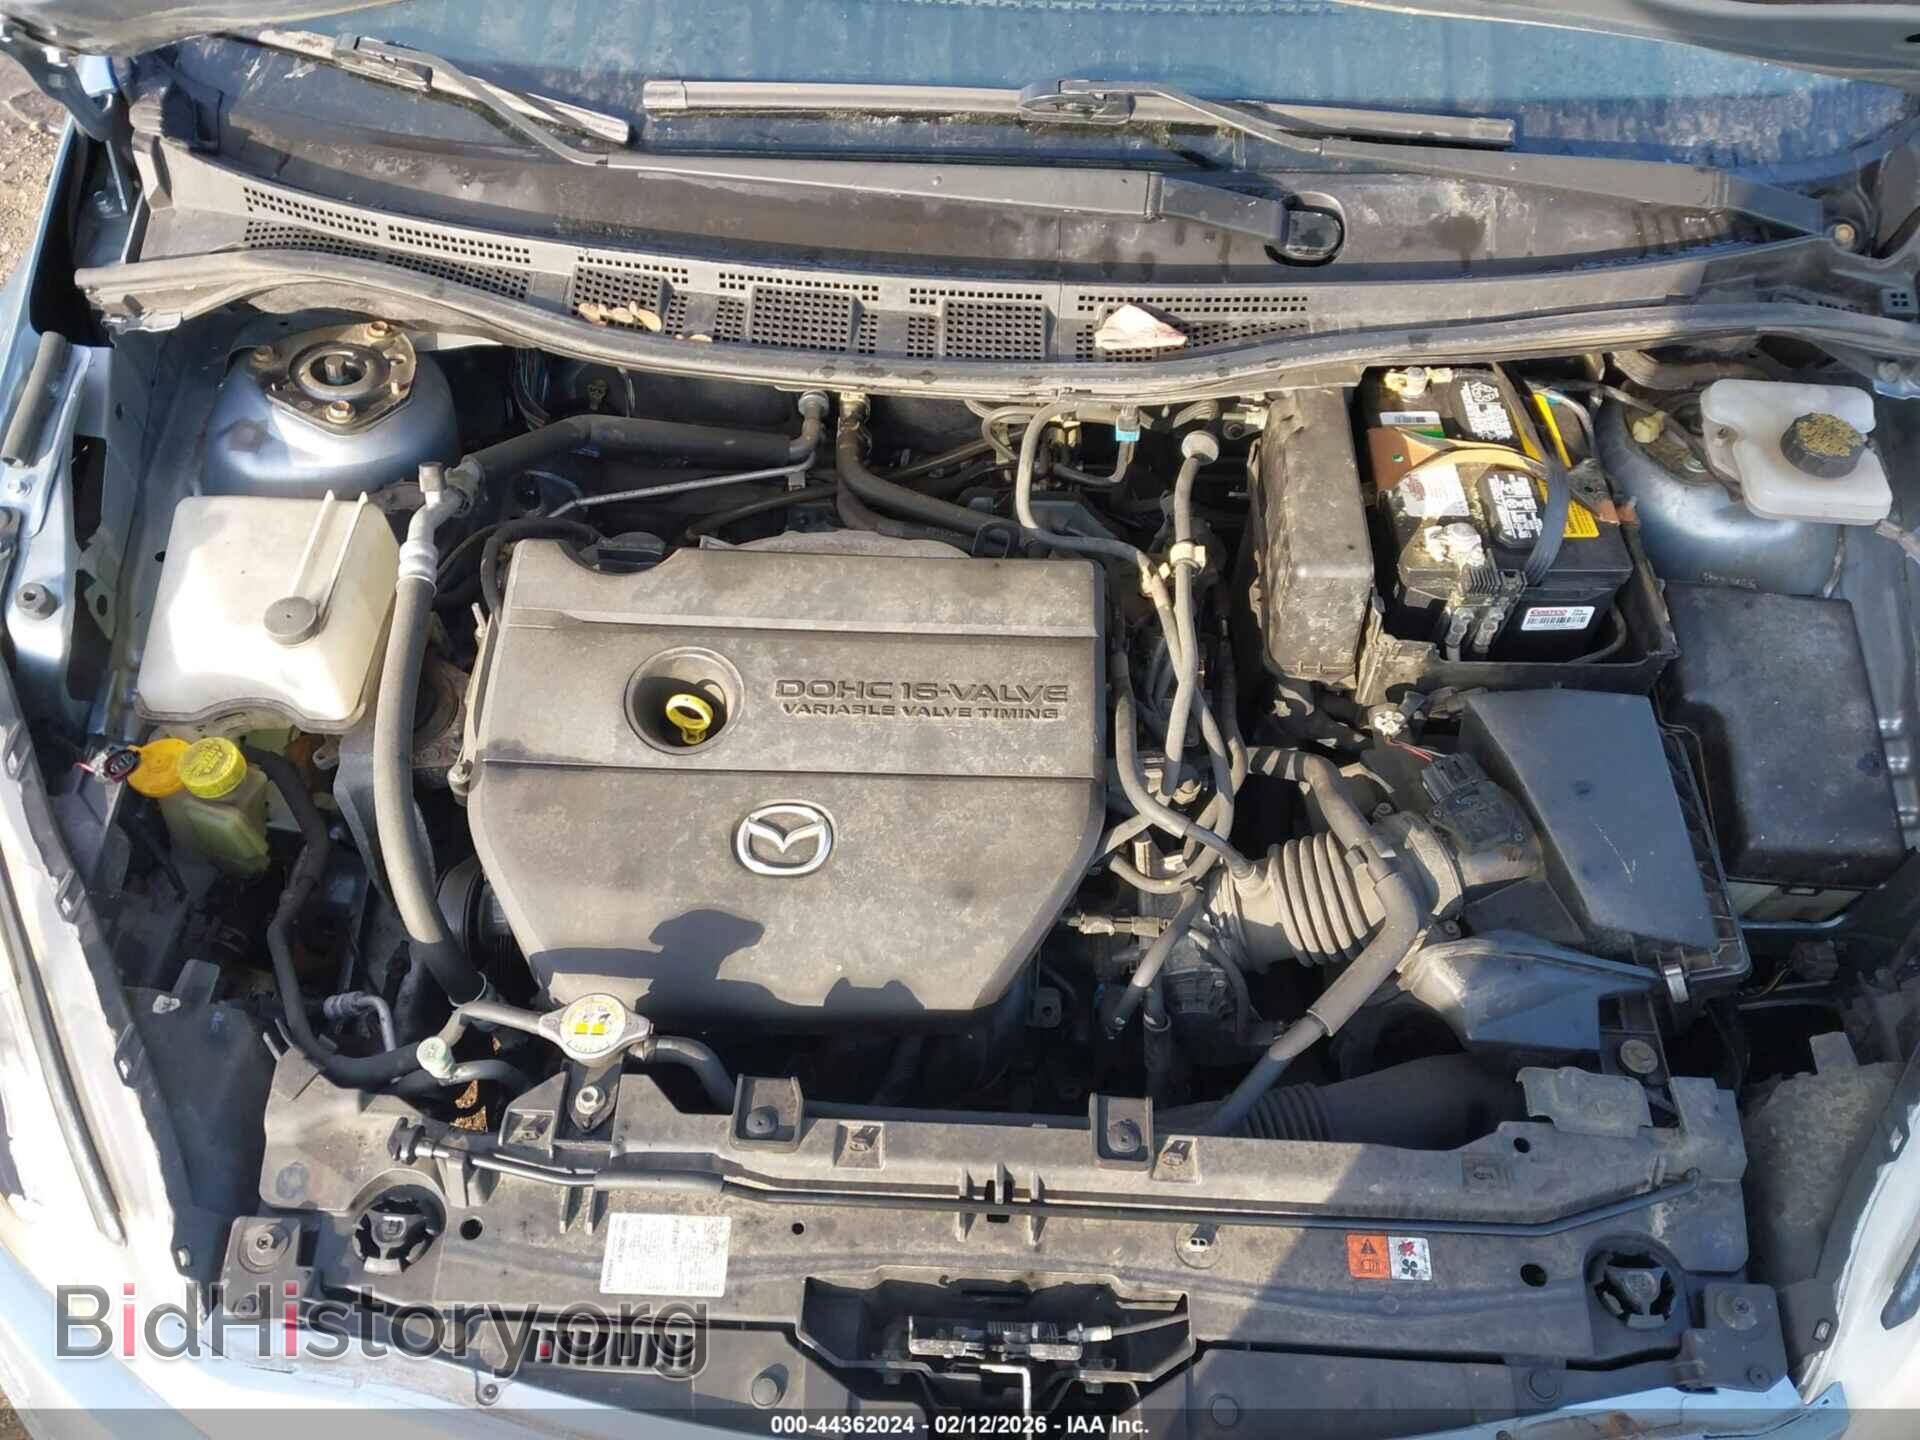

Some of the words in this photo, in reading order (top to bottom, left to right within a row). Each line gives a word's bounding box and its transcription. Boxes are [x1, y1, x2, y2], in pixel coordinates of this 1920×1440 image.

[774, 678, 894, 699] DOHC
[901, 682, 1069, 703] 16-VALVE
[782, 702, 896, 717] VARIABLE
[902, 705, 972, 719] VALVE
[977, 706, 1060, 720] TIMING
